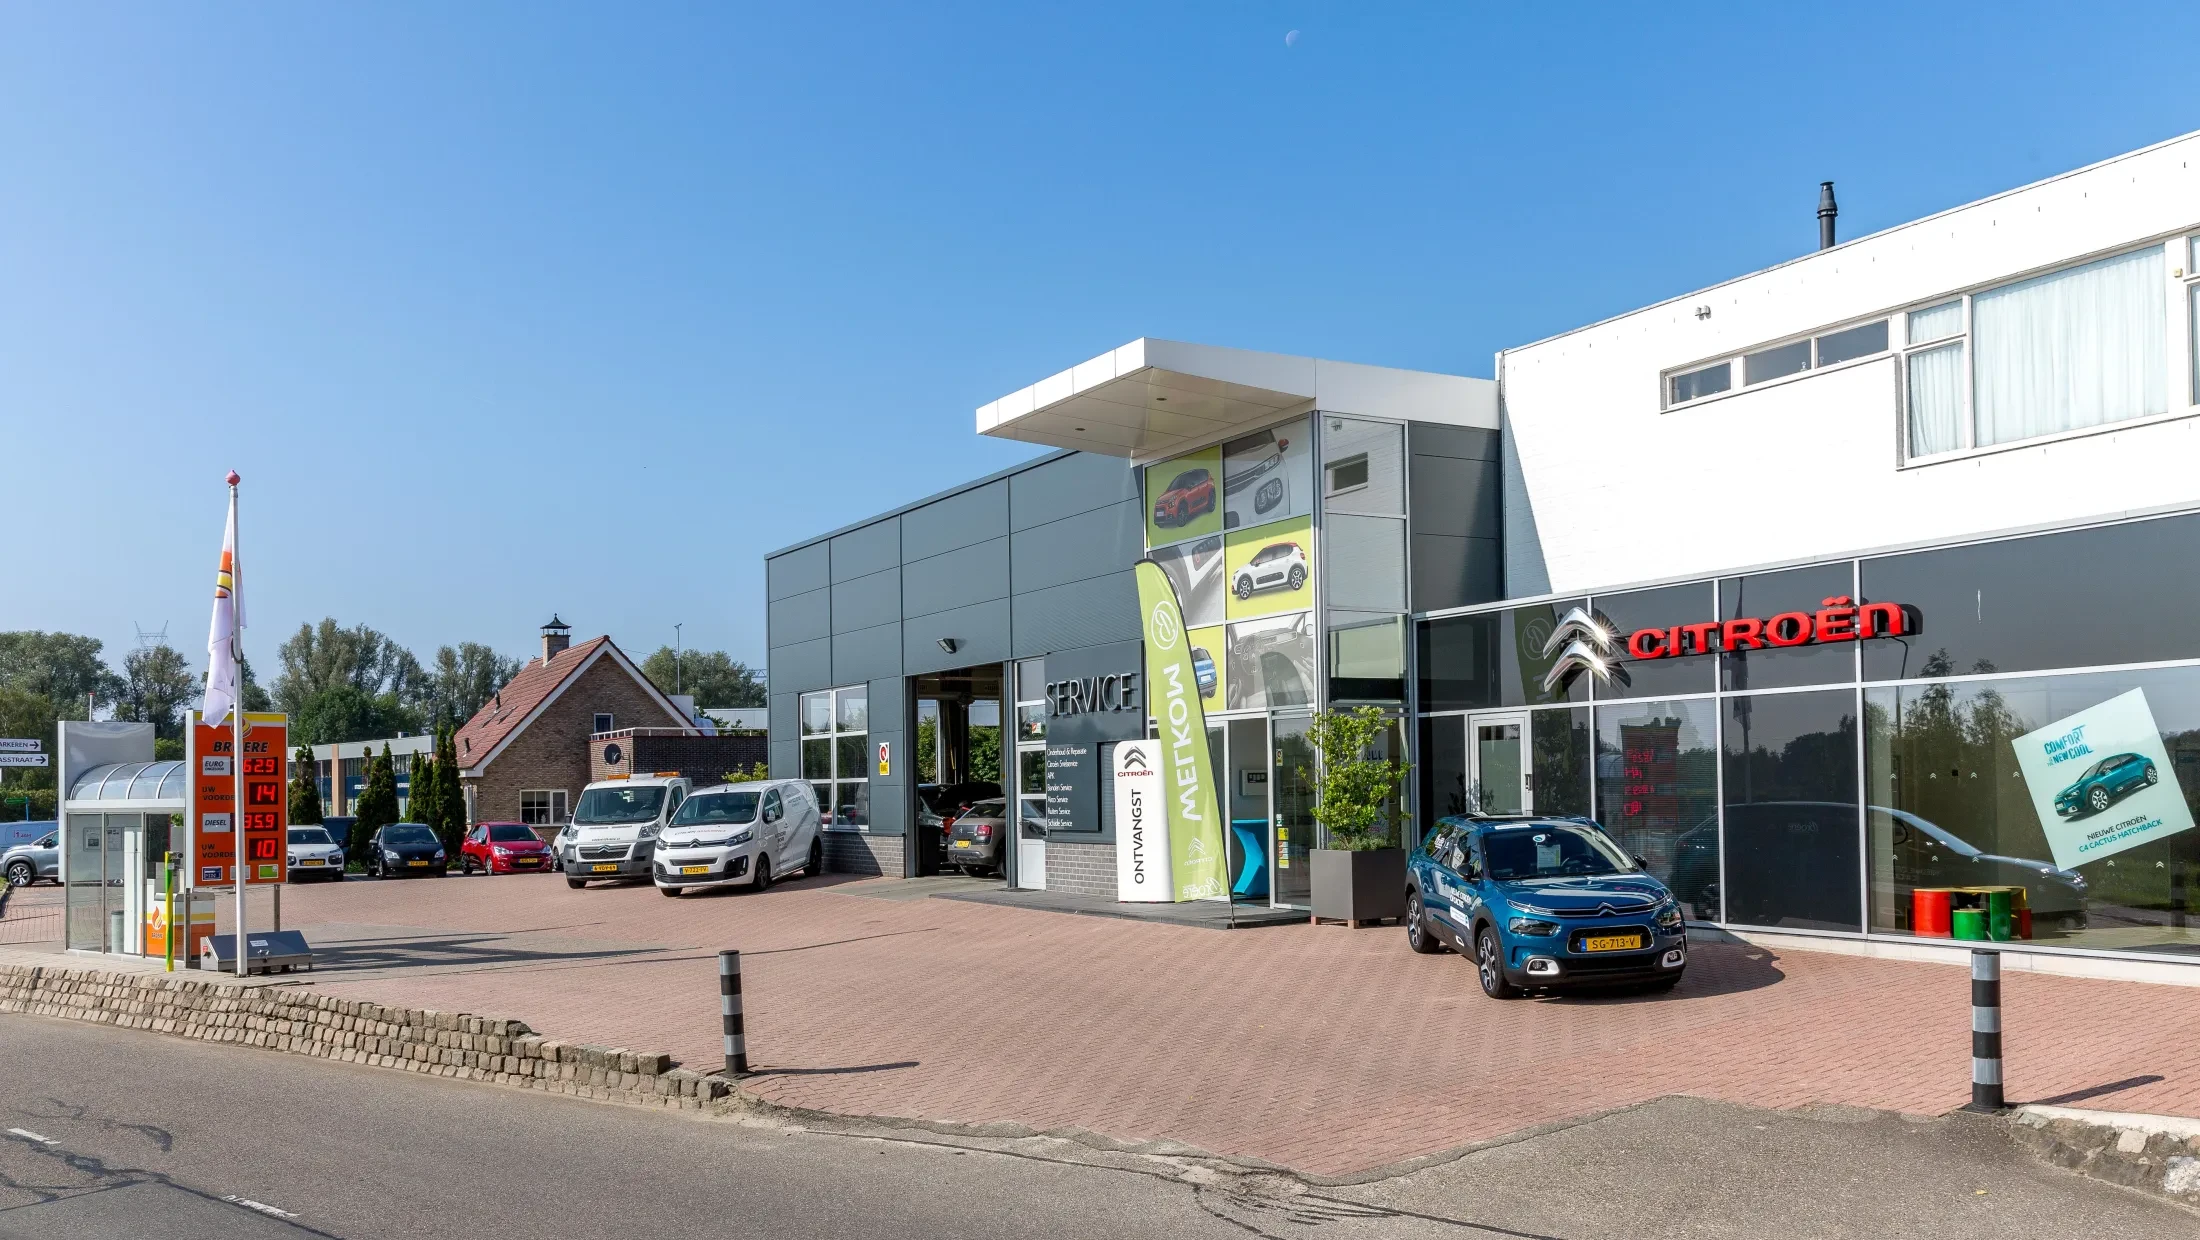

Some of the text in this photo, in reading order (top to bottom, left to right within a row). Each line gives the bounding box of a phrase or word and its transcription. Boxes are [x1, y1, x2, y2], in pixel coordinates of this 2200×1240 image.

[1629, 595, 1904, 659] CITROËN
[1046, 673, 1133, 717] SERVICE
[213, 741, 269, 753] BRERE
[2044, 724, 2086, 754] COMFORT
[2068, 744, 2094, 760] COOL
[1117, 769, 1154, 778] CITROËN
[257, 785, 276, 802] 14
[1057, 795, 1069, 803] Service
[1059, 807, 1071, 815] Service
[1060, 819, 1073, 827] Service
[2087, 815, 2147, 840] NIEUWE CITROËN
[1131, 788, 1145, 885] ONTVANGST
[2079, 819, 2163, 852] C4 CACTUS HATCHBACK
[257, 840, 276, 858] 10
[1592, 937, 1636, 949] SG-713-V
